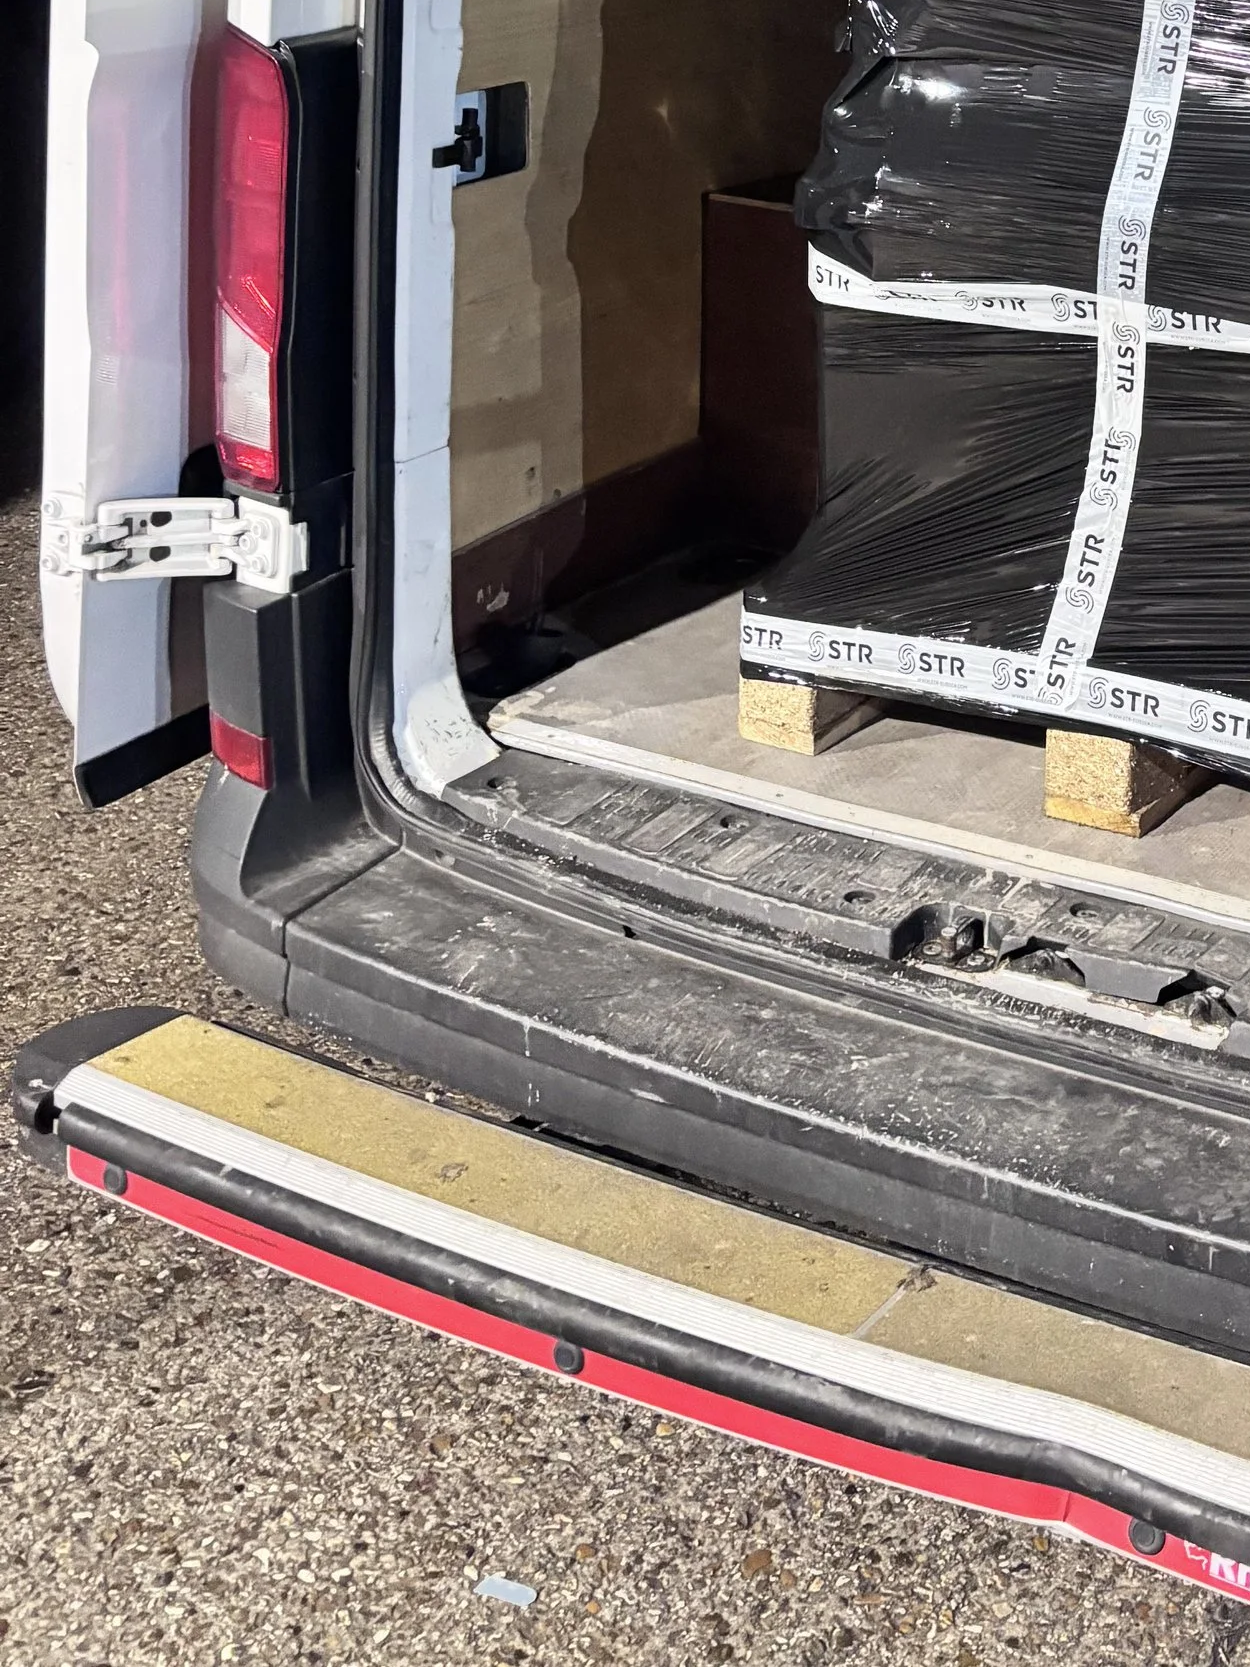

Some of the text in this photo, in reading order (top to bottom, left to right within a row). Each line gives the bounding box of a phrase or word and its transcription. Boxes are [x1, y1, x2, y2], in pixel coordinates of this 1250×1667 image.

[1157, 24, 1181, 75] STR
[1134, 132, 1162, 181] STR
[1118, 240, 1139, 291] STR
[1171, 310, 1222, 333] STR
[1117, 344, 1135, 393] STR
[1077, 534, 1105, 587] STR
[743, 625, 783, 650] STR
[829, 640, 873, 665] STR
[919, 652, 965, 678] STR
[1111, 687, 1160, 717] STR
[1047, 637, 1077, 690] STR
